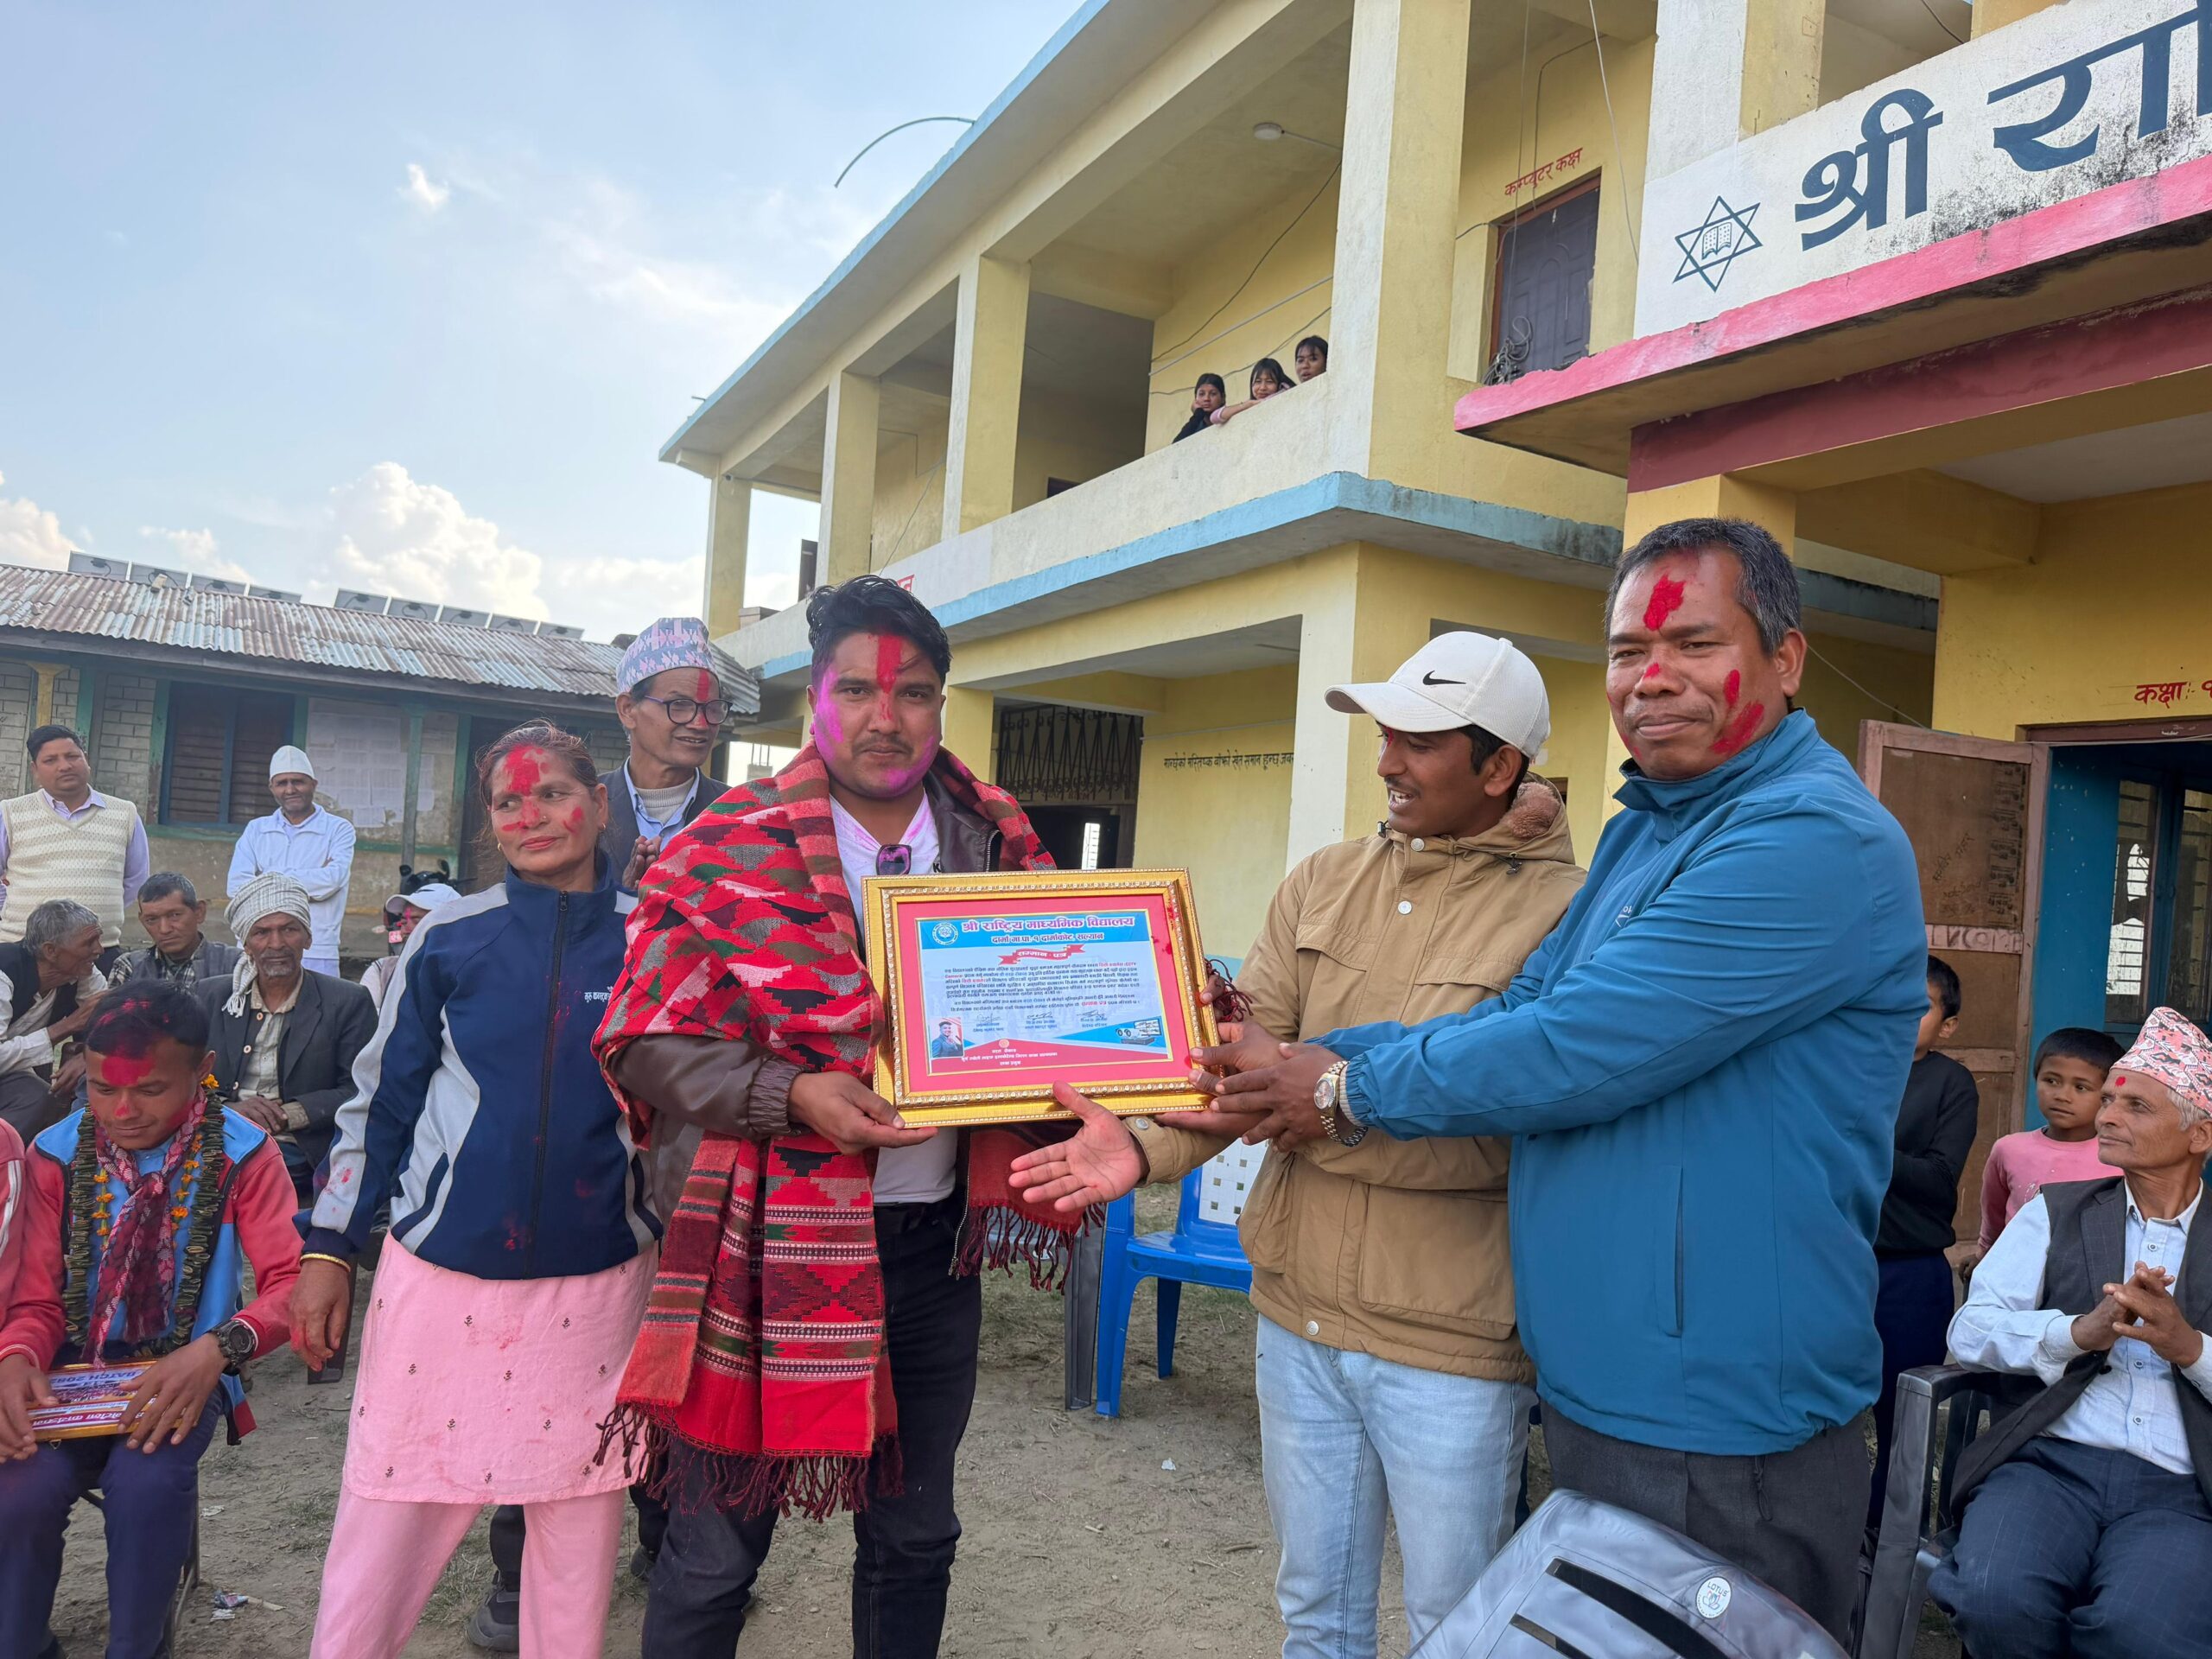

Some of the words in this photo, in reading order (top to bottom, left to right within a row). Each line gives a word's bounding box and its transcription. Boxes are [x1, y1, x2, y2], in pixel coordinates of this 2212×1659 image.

[1556, 147, 1583, 172] कक्ष
[1795, 88, 1942, 251] श्री
[962, 919, 978, 932] श्री
[1027, 916, 1084, 931] माध्यमिक
[1086, 915, 1135, 928] विद्यालय
[87, 1370, 137, 1382] BATCH
[1707, 1582, 1728, 1597] LOTUS
